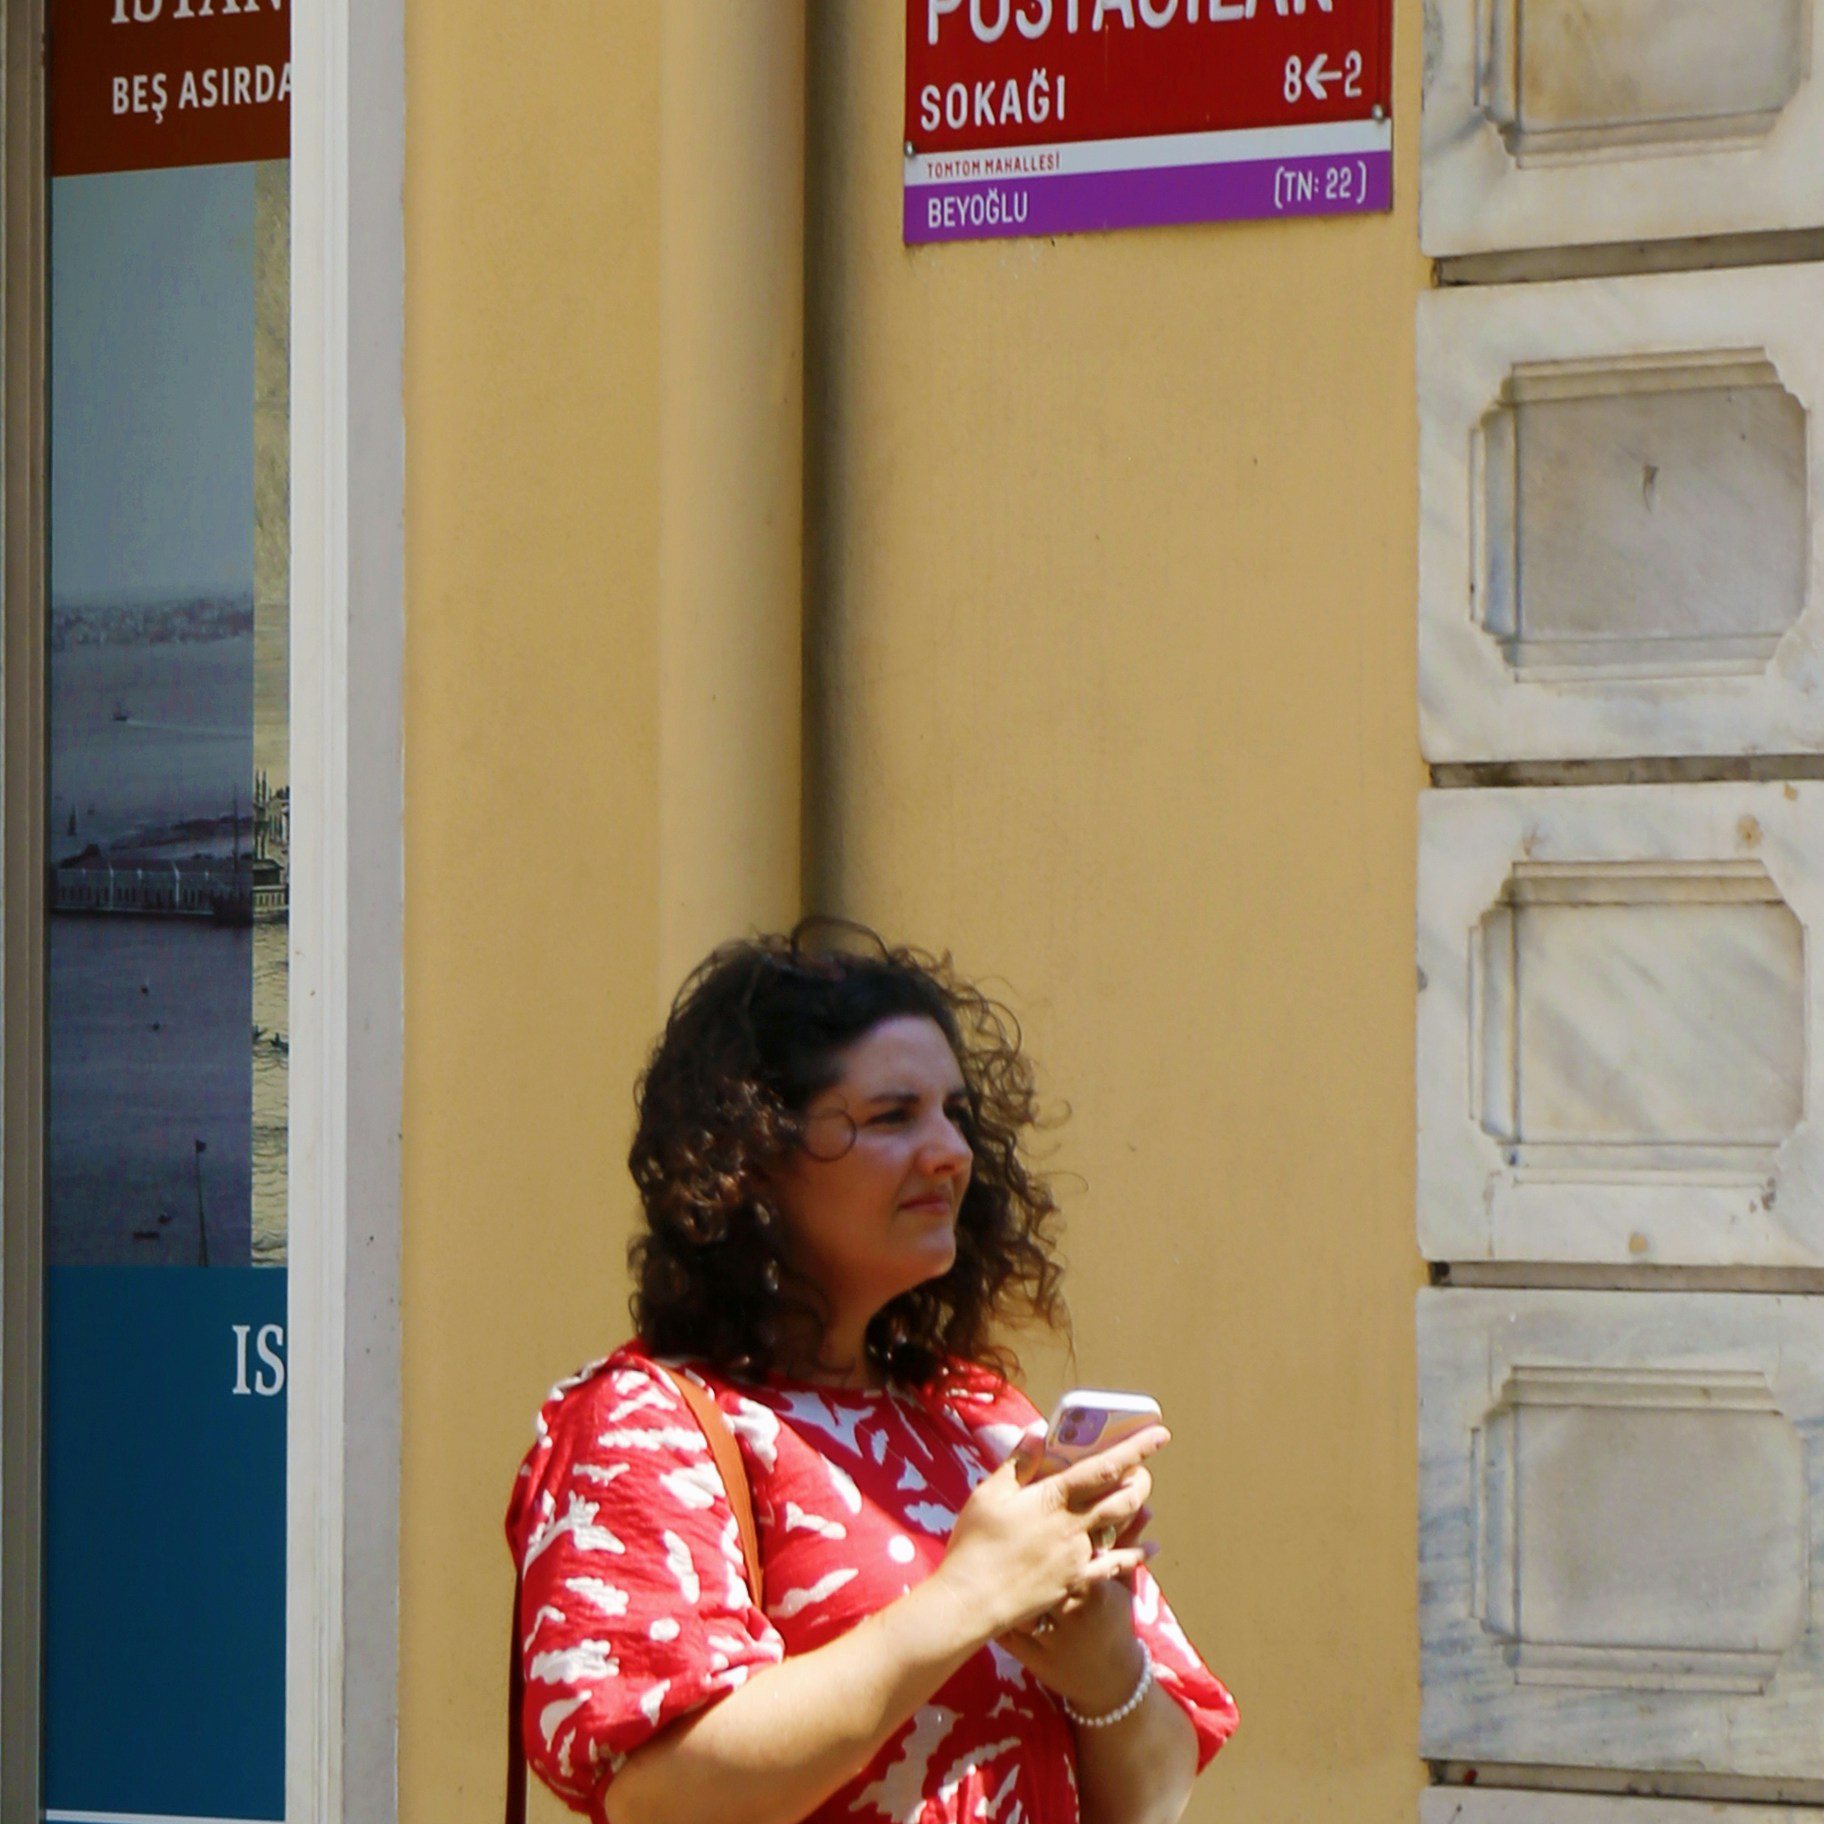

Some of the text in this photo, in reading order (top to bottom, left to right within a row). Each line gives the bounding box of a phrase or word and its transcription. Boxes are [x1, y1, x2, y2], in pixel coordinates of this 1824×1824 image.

[112, 73, 168, 125] BEŞ
[920, 67, 1066, 132] SOKAĞI
[927, 159, 981, 179] TOMTOM
[928, 187, 1028, 229] BEYOĞLU
